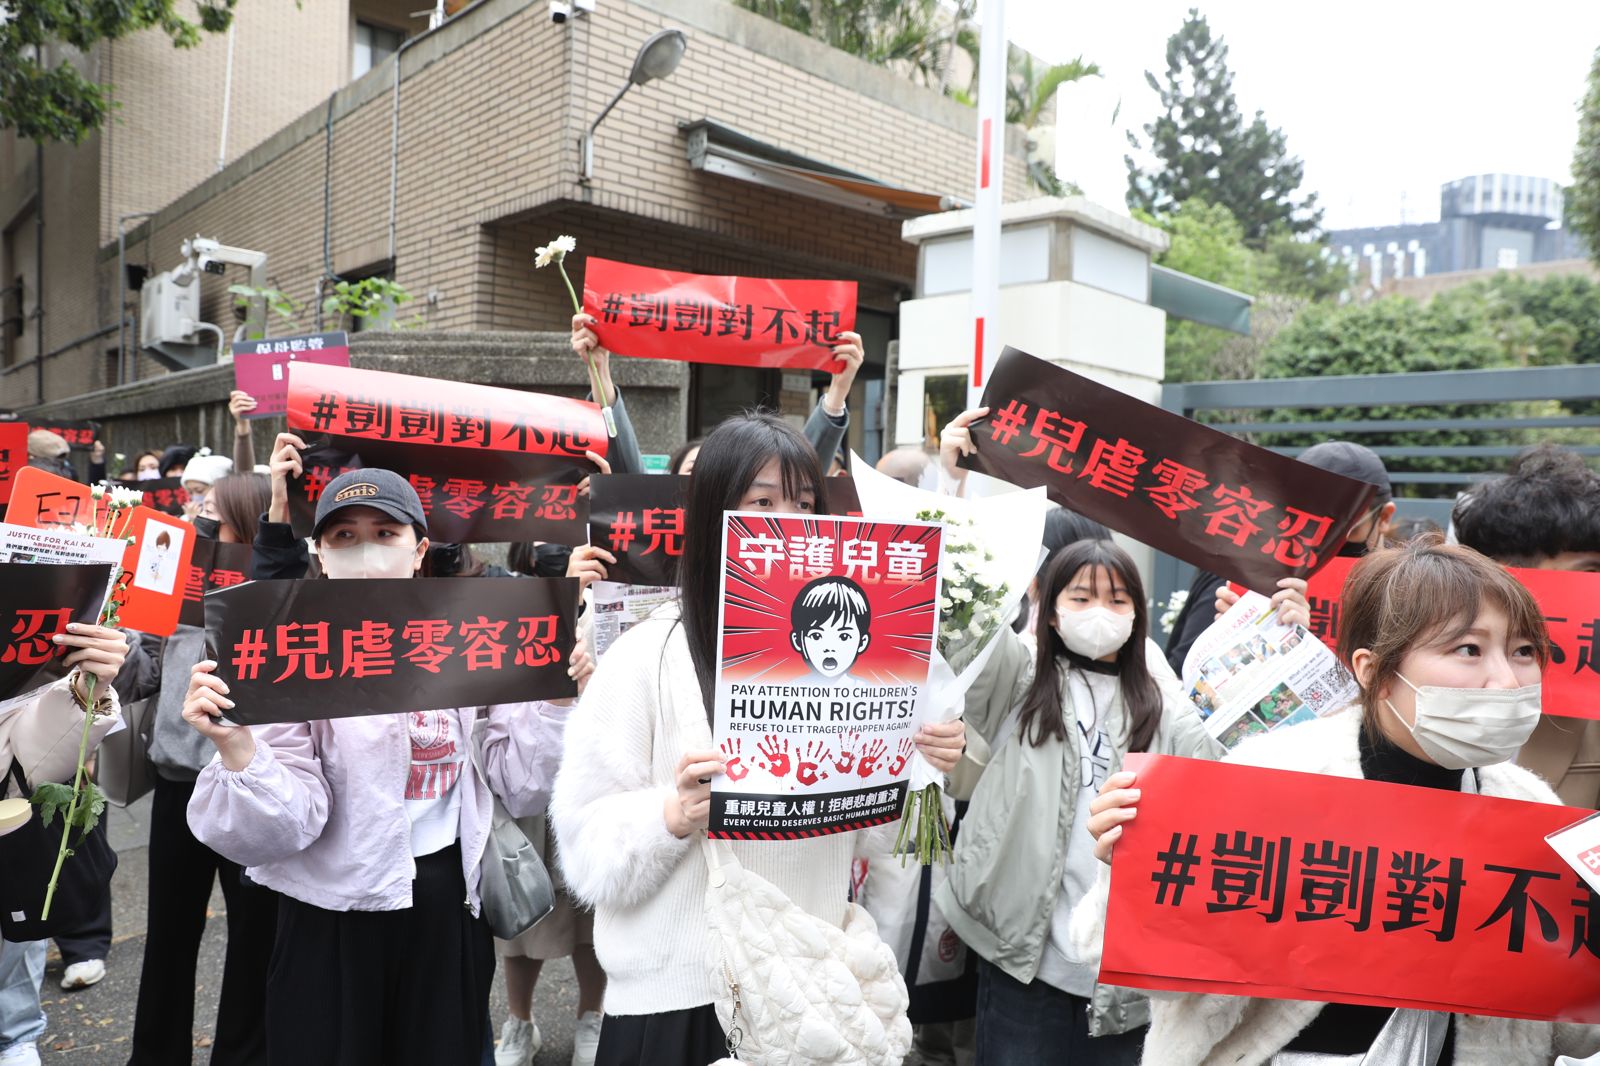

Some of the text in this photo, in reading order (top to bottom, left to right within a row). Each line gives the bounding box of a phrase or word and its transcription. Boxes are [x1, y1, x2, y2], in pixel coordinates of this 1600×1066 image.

[601, 293, 841, 347] #剴剴對不起
[310, 394, 591, 456] #剴剴對不起
[304, 465, 577, 520] #虐零容忍
[335, 485, 378, 502] emis
[990, 399, 1335, 569] #兒虐零容忍
[7, 530, 41, 541] JUSTICE
[44, 536, 61, 545] FOR
[63, 539, 79, 547] KAI
[80, 541, 95, 549] KAI
[738, 532, 928, 585] 守護兒童
[232, 615, 561, 684] #兒虐零容忍
[731, 684, 918, 698] PAY ATTENTION TO CHILDREN'S
[730, 698, 915, 721] HUMAN RIGHTS!
[730, 721, 912, 734] REFUSE TO LET TRAGEDY HAPPEN AGAIN!
[723, 803, 897, 827] EVERY CHILD DESERVES BASIC HUMAN RIGHTS!
[724, 788, 899, 816] 重視兒童人權！拒絕悲劇重演
